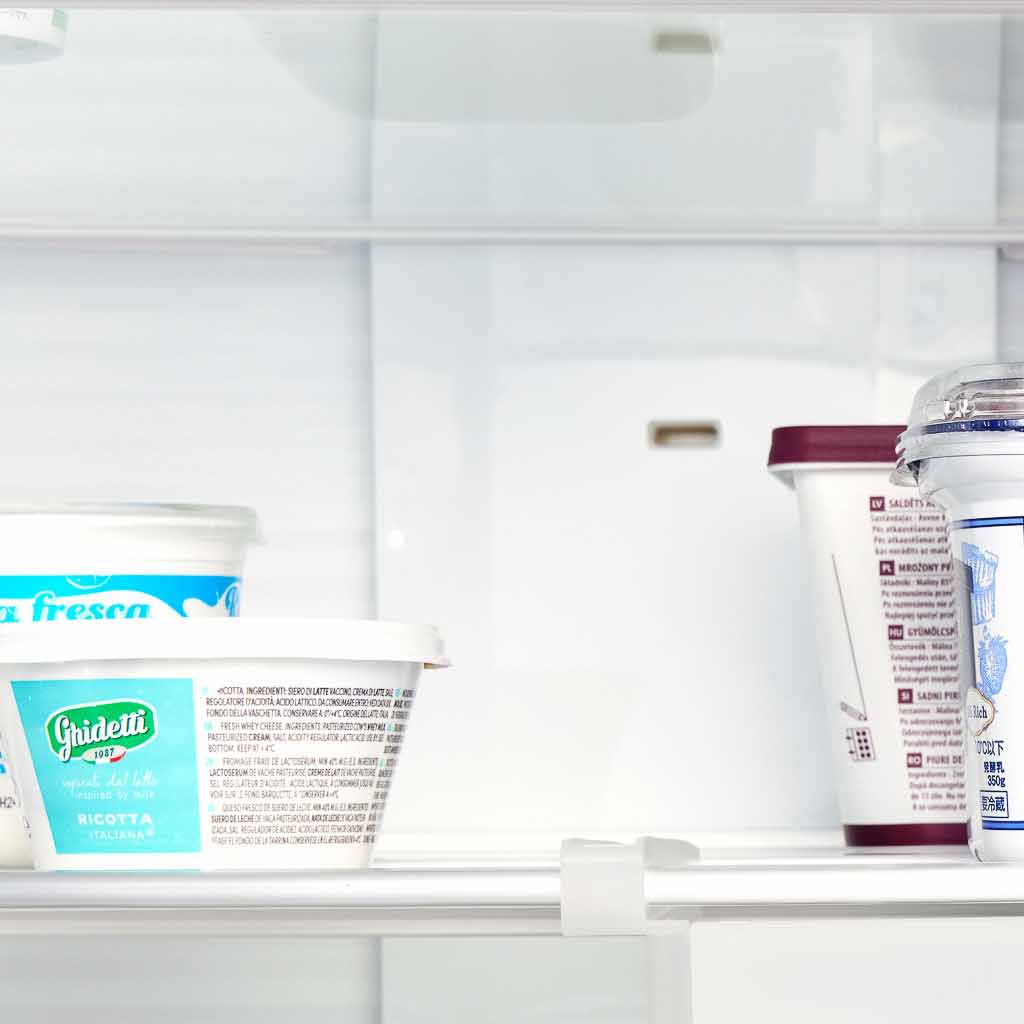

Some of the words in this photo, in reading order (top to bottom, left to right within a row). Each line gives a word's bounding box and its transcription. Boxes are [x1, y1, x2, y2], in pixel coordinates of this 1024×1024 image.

[32, 590, 152, 622] fresca
[54, 709, 150, 763] Ghidetti
[987, 774, 1006, 788] 350g
[77, 813, 153, 826] RICOTTA
